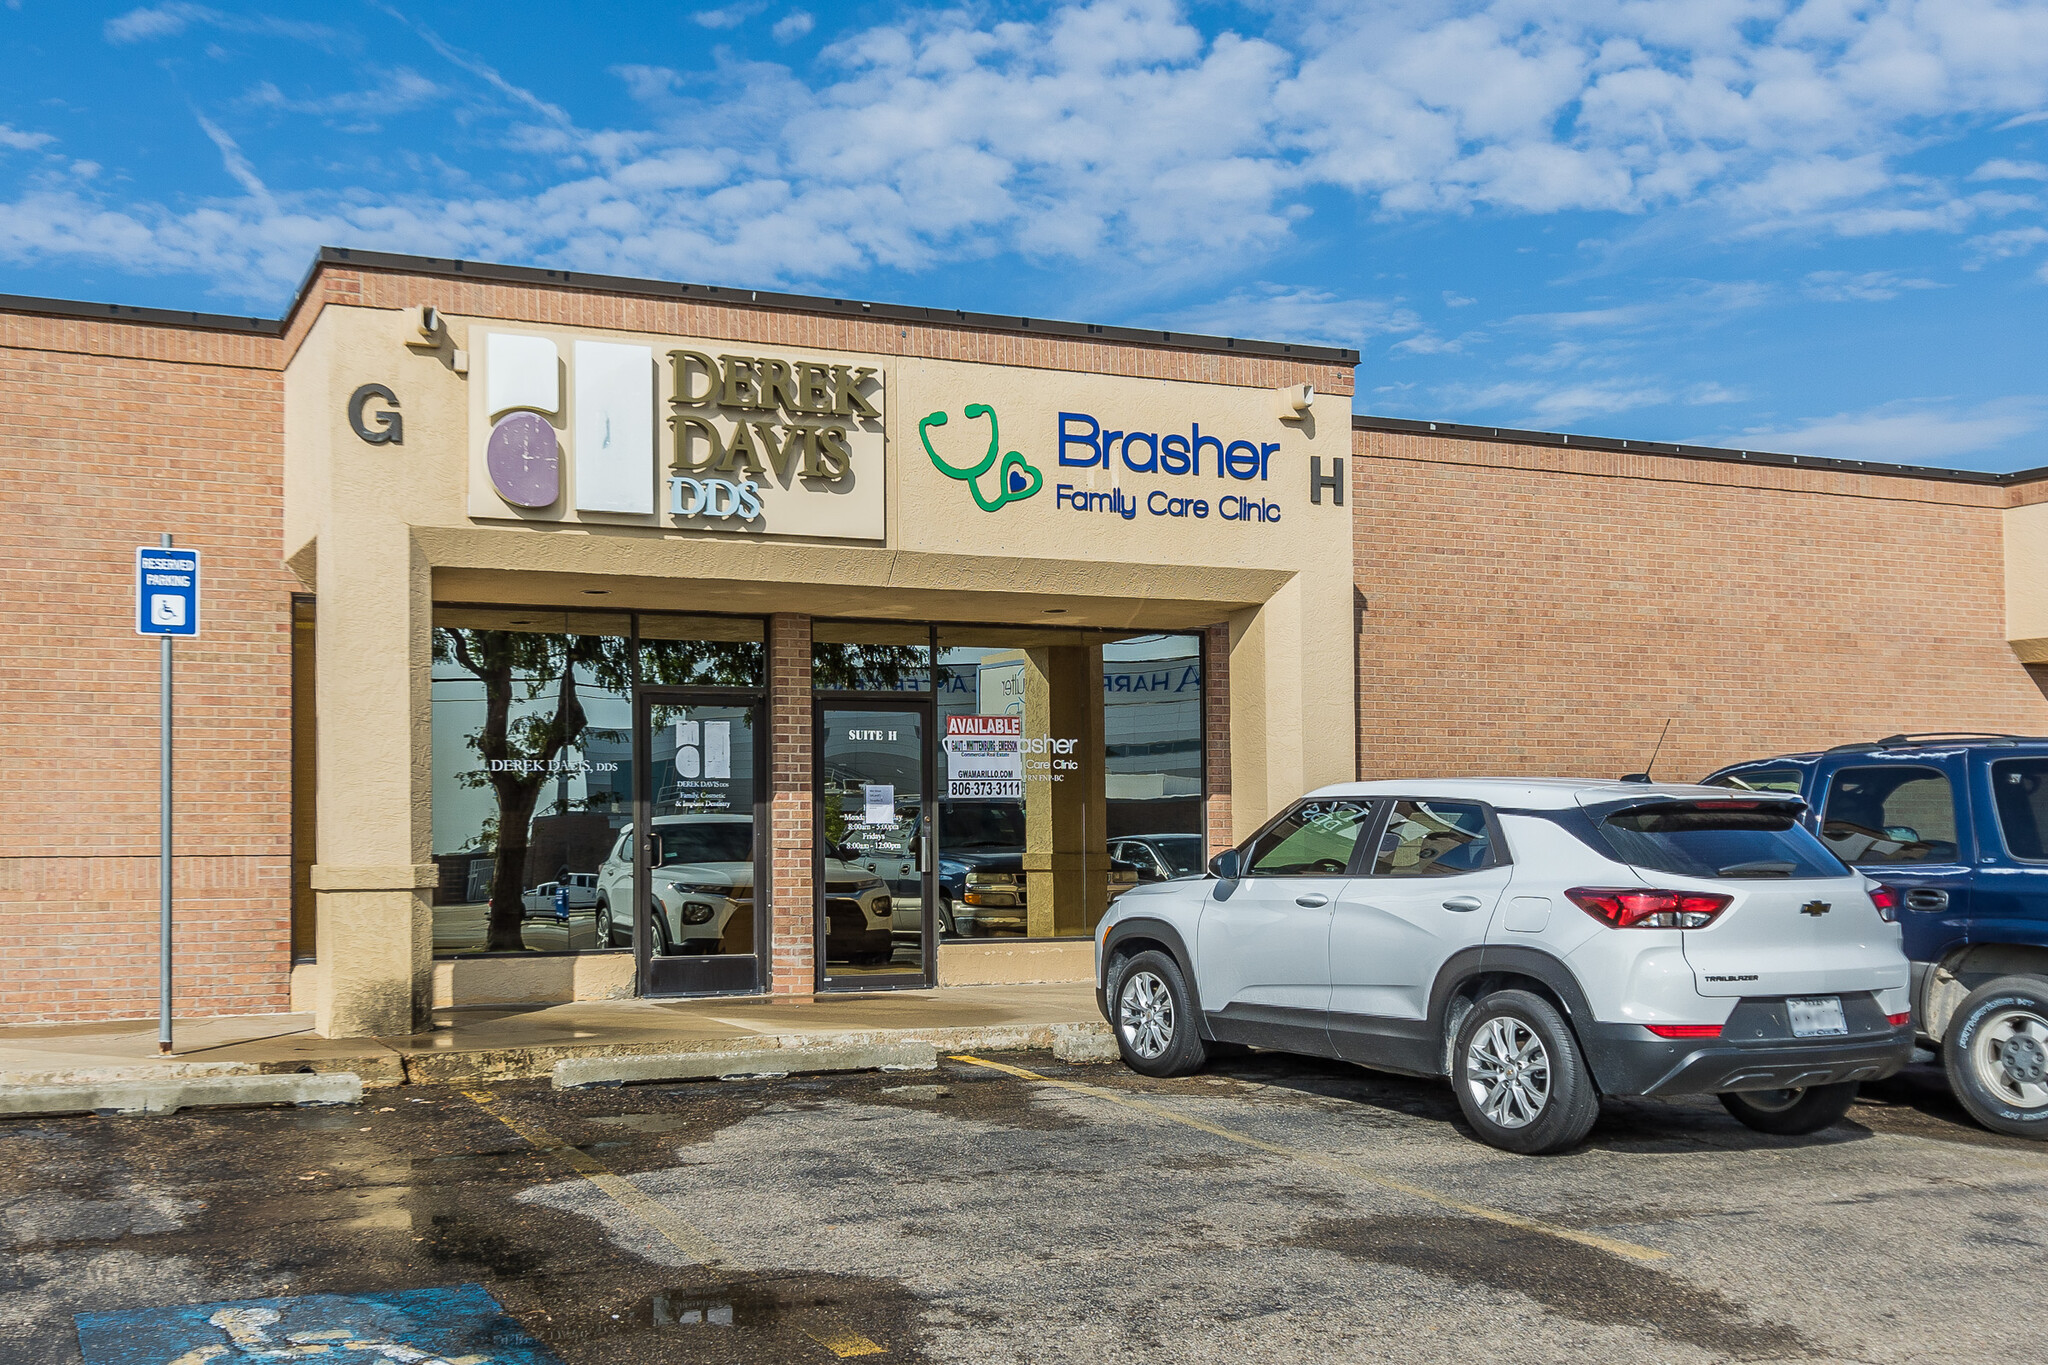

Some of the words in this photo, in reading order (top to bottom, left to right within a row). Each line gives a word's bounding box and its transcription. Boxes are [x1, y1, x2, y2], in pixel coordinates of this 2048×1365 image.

[667, 349, 882, 418] DEREK
[348, 383, 404, 445] G
[667, 415, 852, 479] DAVIS
[1058, 411, 1281, 480] Brasher
[1310, 456, 1344, 507] H
[667, 476, 762, 519] DDS
[1057, 484, 1137, 519] Family
[1147, 491, 1209, 518] Care
[1218, 495, 1282, 522] Clinic
[142, 557, 195, 571] RESERVED
[146, 574, 191, 587] PARKING
[948, 717, 1020, 734] AVAILABLE
[848, 729, 884, 741] SUITE
[888, 730, 897, 741] H
[1019, 733, 1078, 754] asher
[490, 759, 545, 772] DEREK
[596, 762, 619, 772] DDS
[1025, 759, 1051, 770] Care
[1053, 759, 1079, 770] Clinic
[958, 770, 1014, 779] GWAMARILLO.COM
[676, 780, 700, 788] DEREK
[700, 780, 719, 788] DAVIS
[951, 781, 1020, 796] 806-373-3111
[700, 791, 726, 799] Cosmetic
[848, 823, 871, 831] 8:00am
[862, 832, 886, 841] Fridays
[846, 841, 870, 850] 8:00am
[875, 841, 902, 851] 12:00pm
[1704, 974, 1759, 982] TRAILBLAZER
